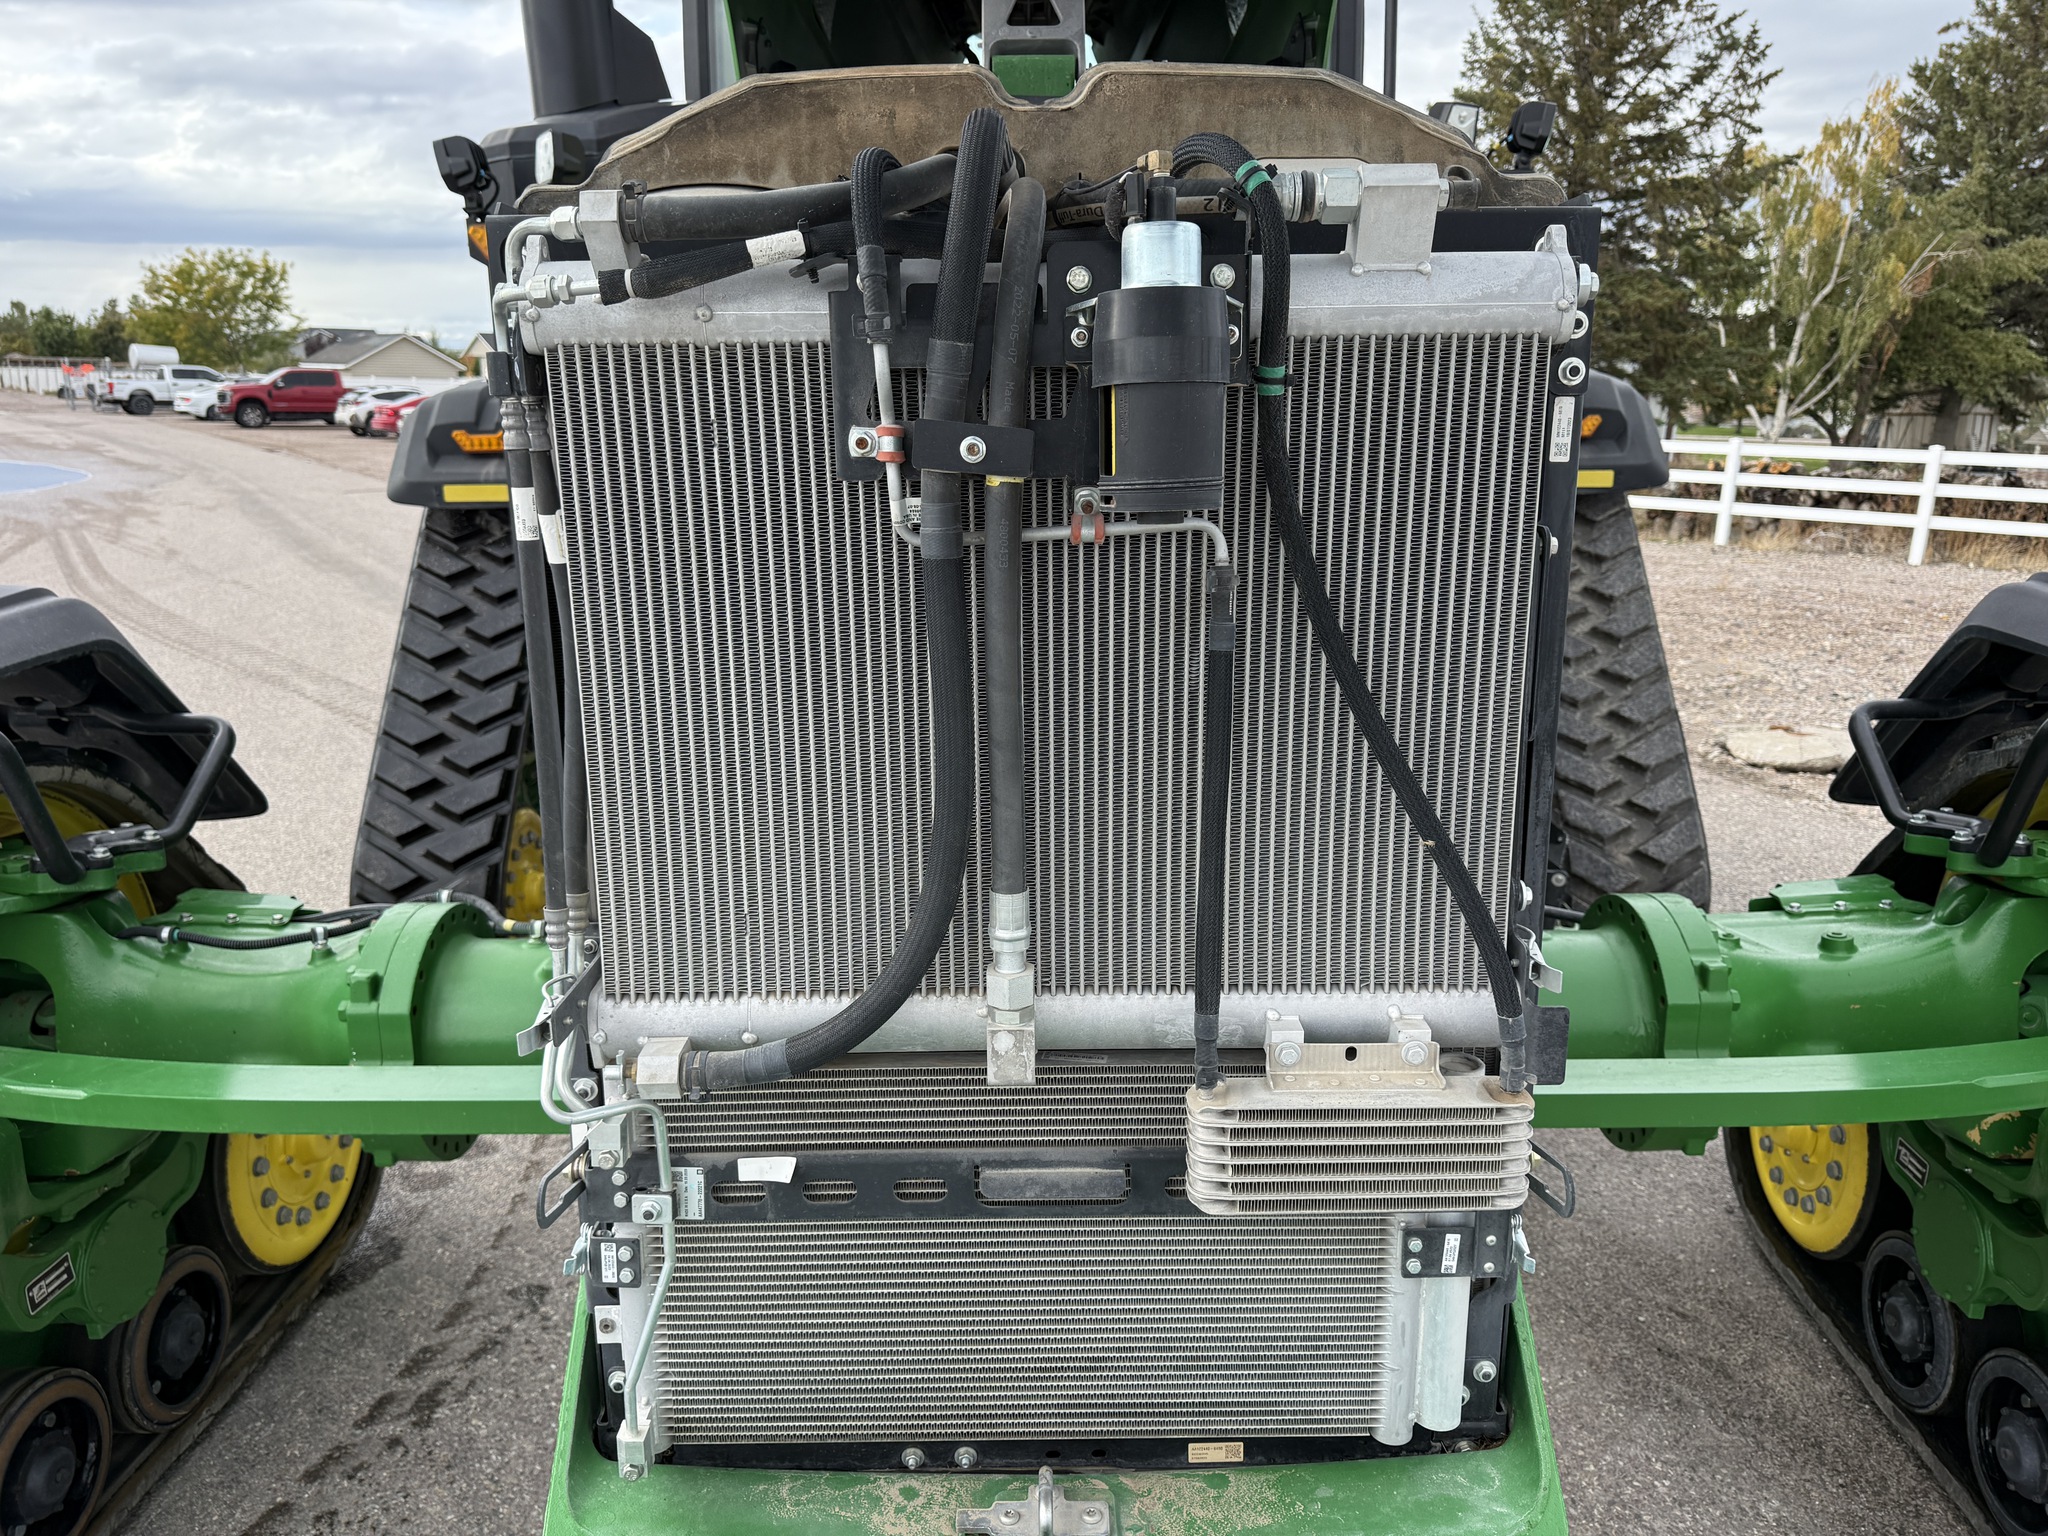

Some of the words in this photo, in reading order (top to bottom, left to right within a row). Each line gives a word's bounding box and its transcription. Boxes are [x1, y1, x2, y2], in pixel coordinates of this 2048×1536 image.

[1007, 285, 1024, 364] 2022-05-07
[1003, 381, 1015, 413] Made
[999, 518, 1009, 568] 4800433
